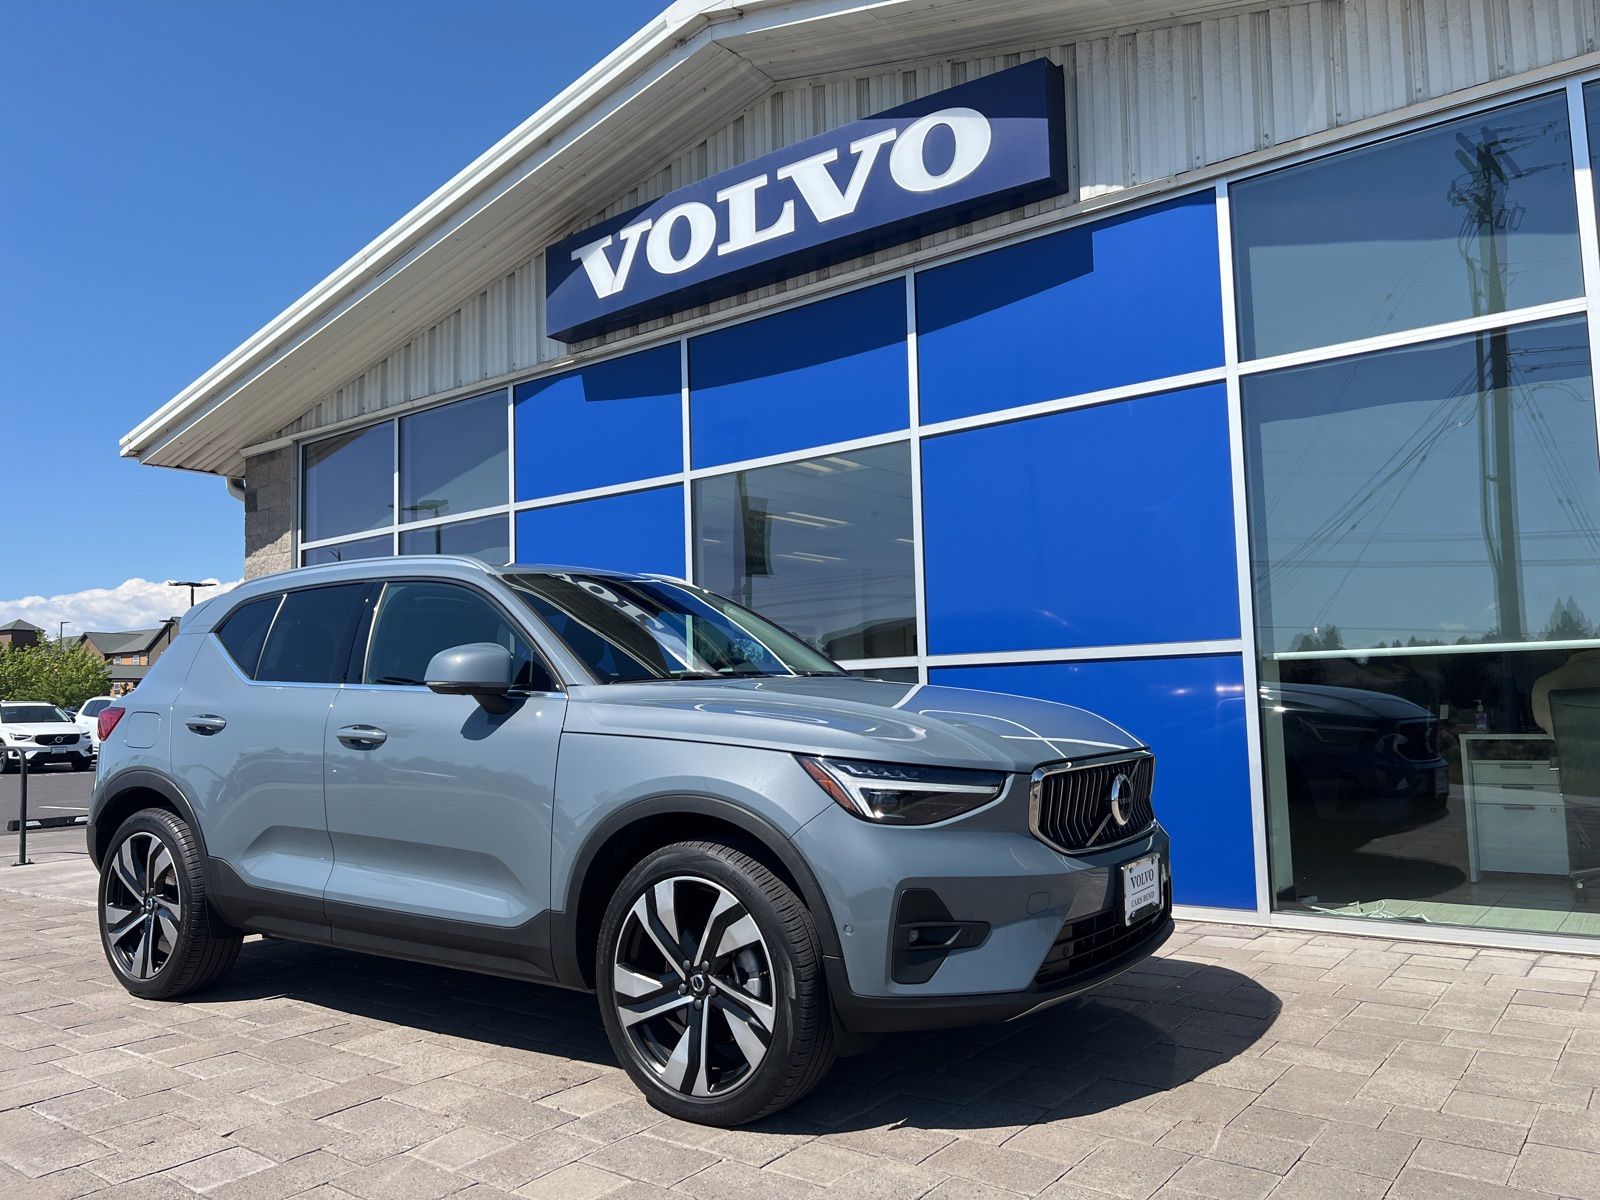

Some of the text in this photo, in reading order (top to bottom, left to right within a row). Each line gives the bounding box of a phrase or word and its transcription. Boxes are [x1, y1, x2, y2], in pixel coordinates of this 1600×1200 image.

[570, 106, 992, 299] VOLVO
[1130, 869, 1154, 889] VOLVO
[1131, 891, 1155, 907] CARS BEND
